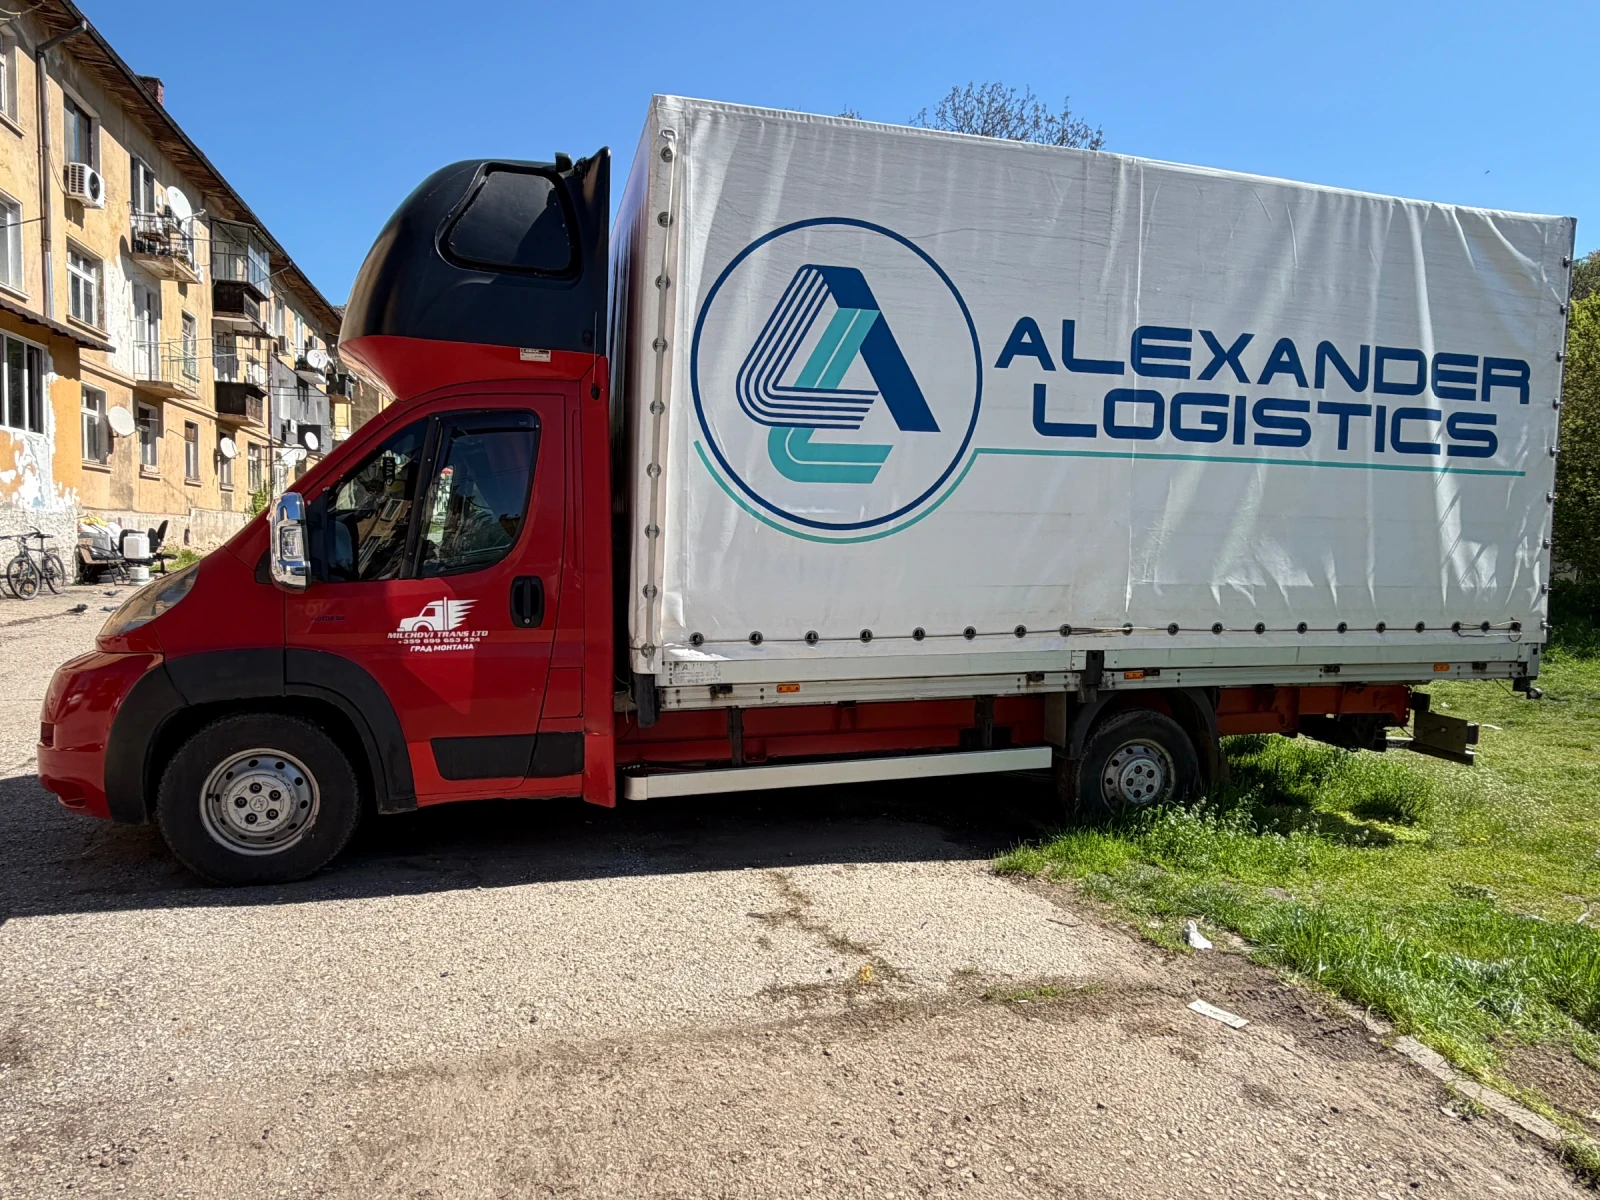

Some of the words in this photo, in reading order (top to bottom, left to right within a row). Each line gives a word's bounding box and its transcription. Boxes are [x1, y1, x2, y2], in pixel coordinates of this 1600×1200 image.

[995, 315, 1530, 405] ALEXANDER
[1032, 383, 1498, 459] LOGISTICS
[433, 643, 474, 651] МОНТАНА
